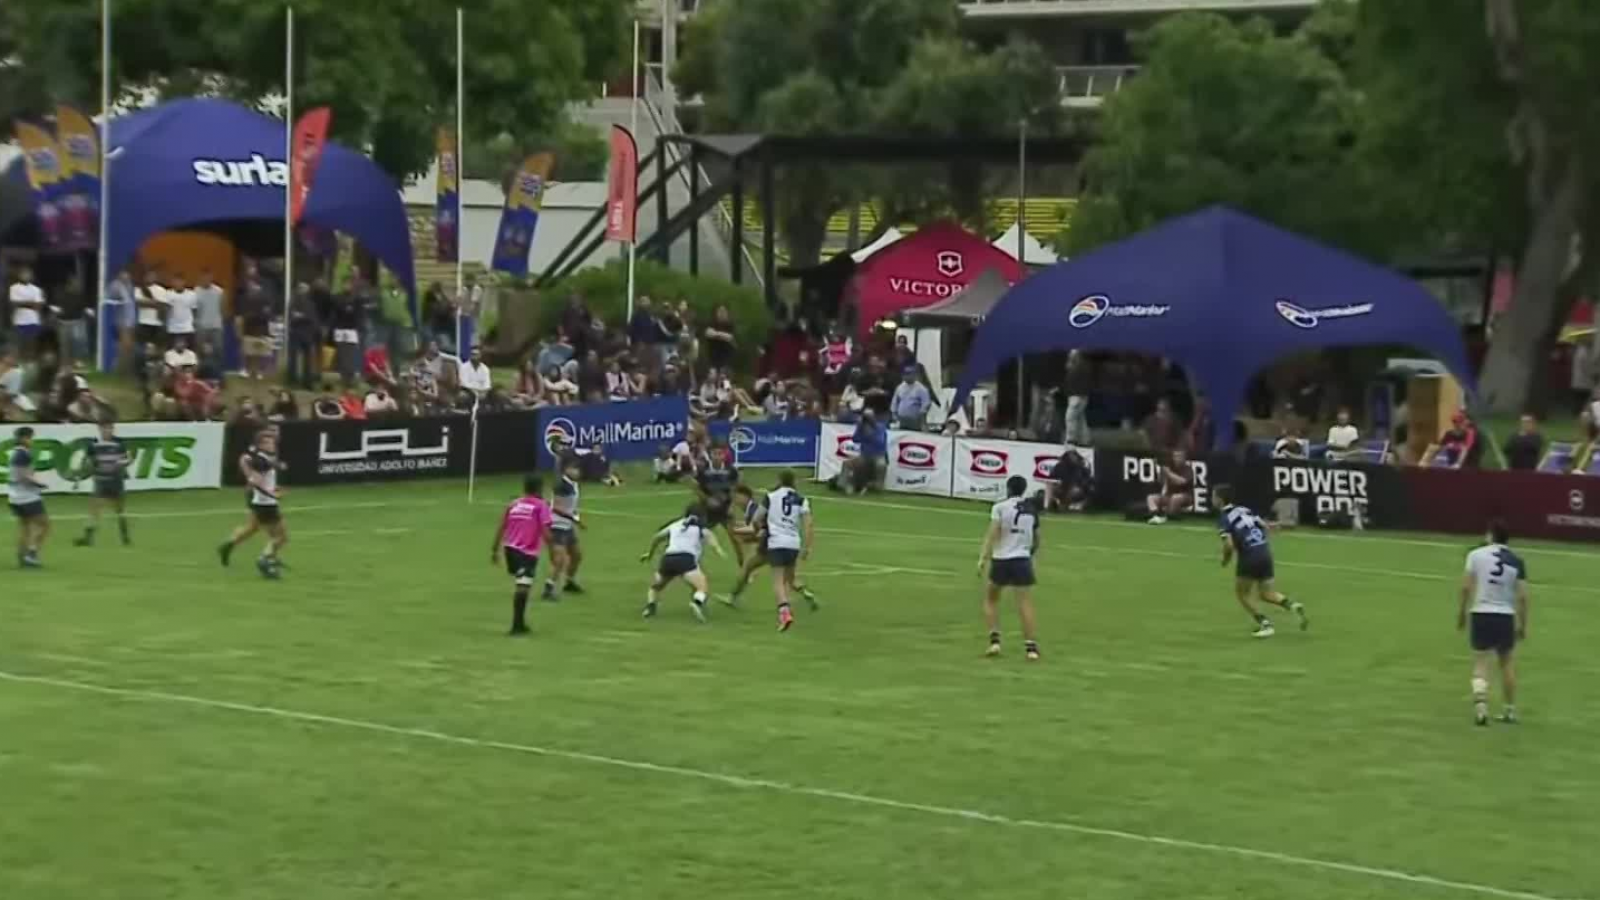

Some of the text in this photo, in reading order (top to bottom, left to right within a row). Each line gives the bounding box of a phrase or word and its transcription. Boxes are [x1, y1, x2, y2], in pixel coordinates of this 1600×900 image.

[580, 420, 676, 446] MallMarina
[1273, 466, 1367, 496] POWER
[1489, 551, 1505, 577] 3
